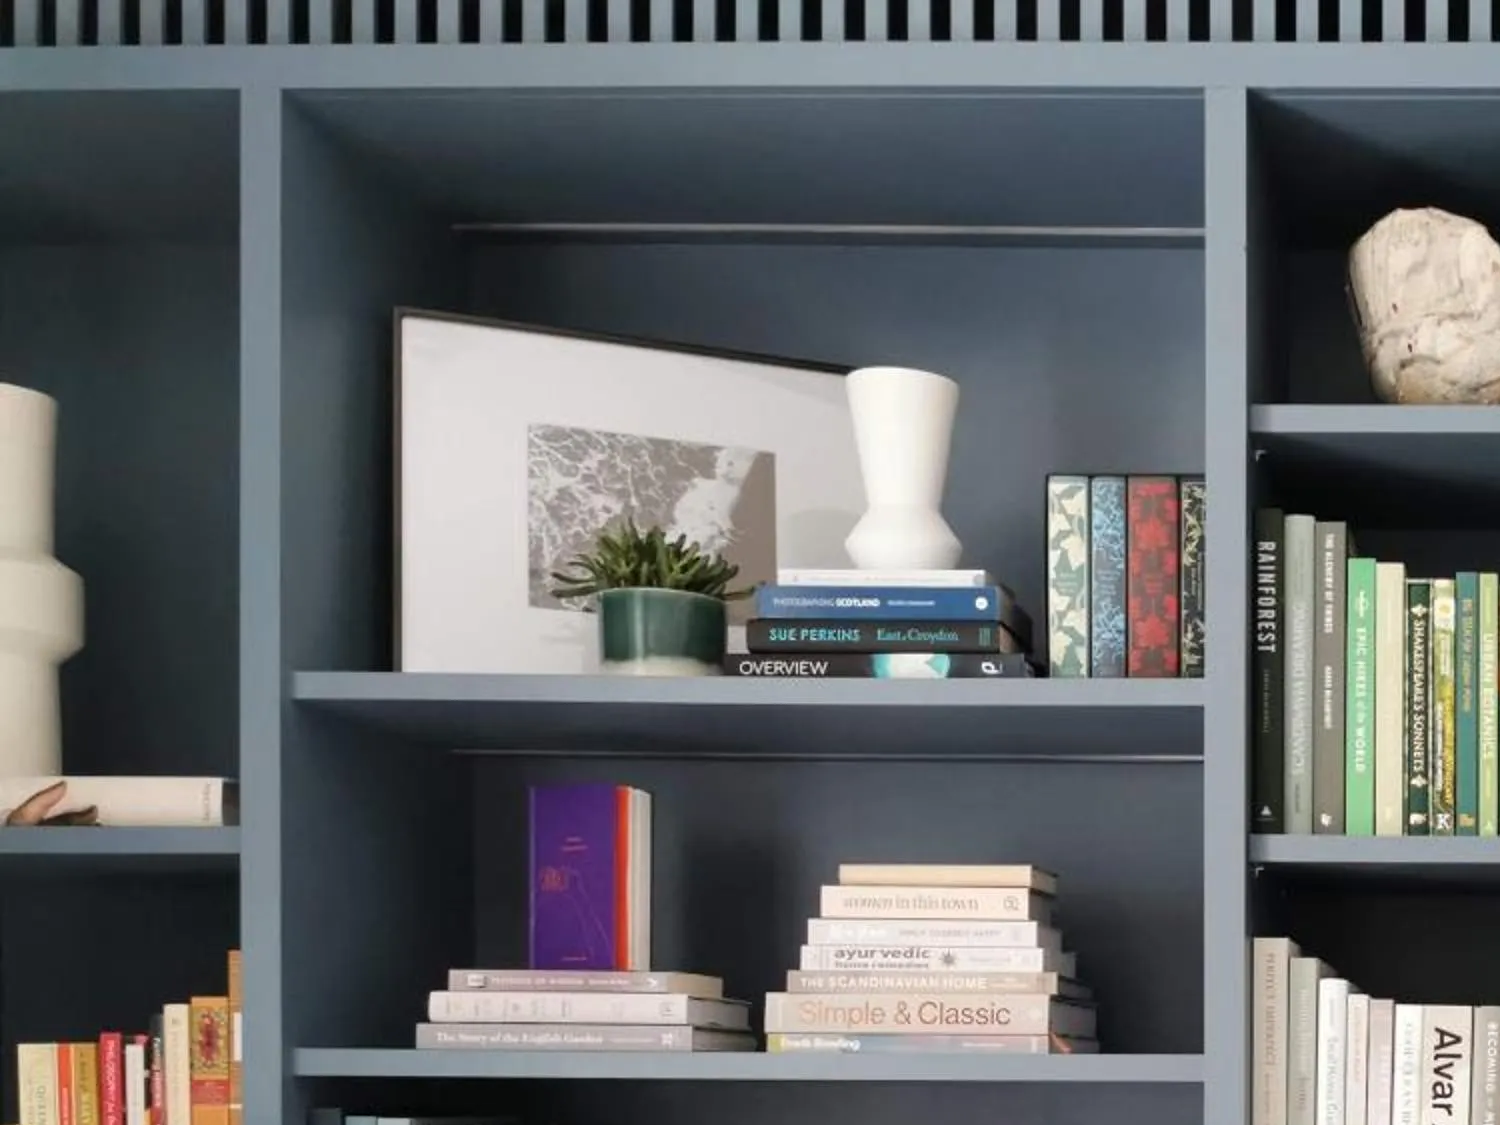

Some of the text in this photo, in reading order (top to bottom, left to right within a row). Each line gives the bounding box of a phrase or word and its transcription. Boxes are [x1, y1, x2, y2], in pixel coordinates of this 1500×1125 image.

[1256, 540, 1277, 654] RAINFOREST
[769, 628, 861, 642] SUE PERKINS
[739, 661, 829, 676] OVERVIEW
[1412, 715, 1425, 772] SONNETS
[834, 946, 931, 962] ayurvedic
[800, 976, 988, 991] THE SCANDINAVIAN HOME
[798, 1001, 1012, 1029] Simple & Classic
[1485, 1021, 1499, 1092] BECOMING
[1431, 1028, 1464, 1117] Alvar
